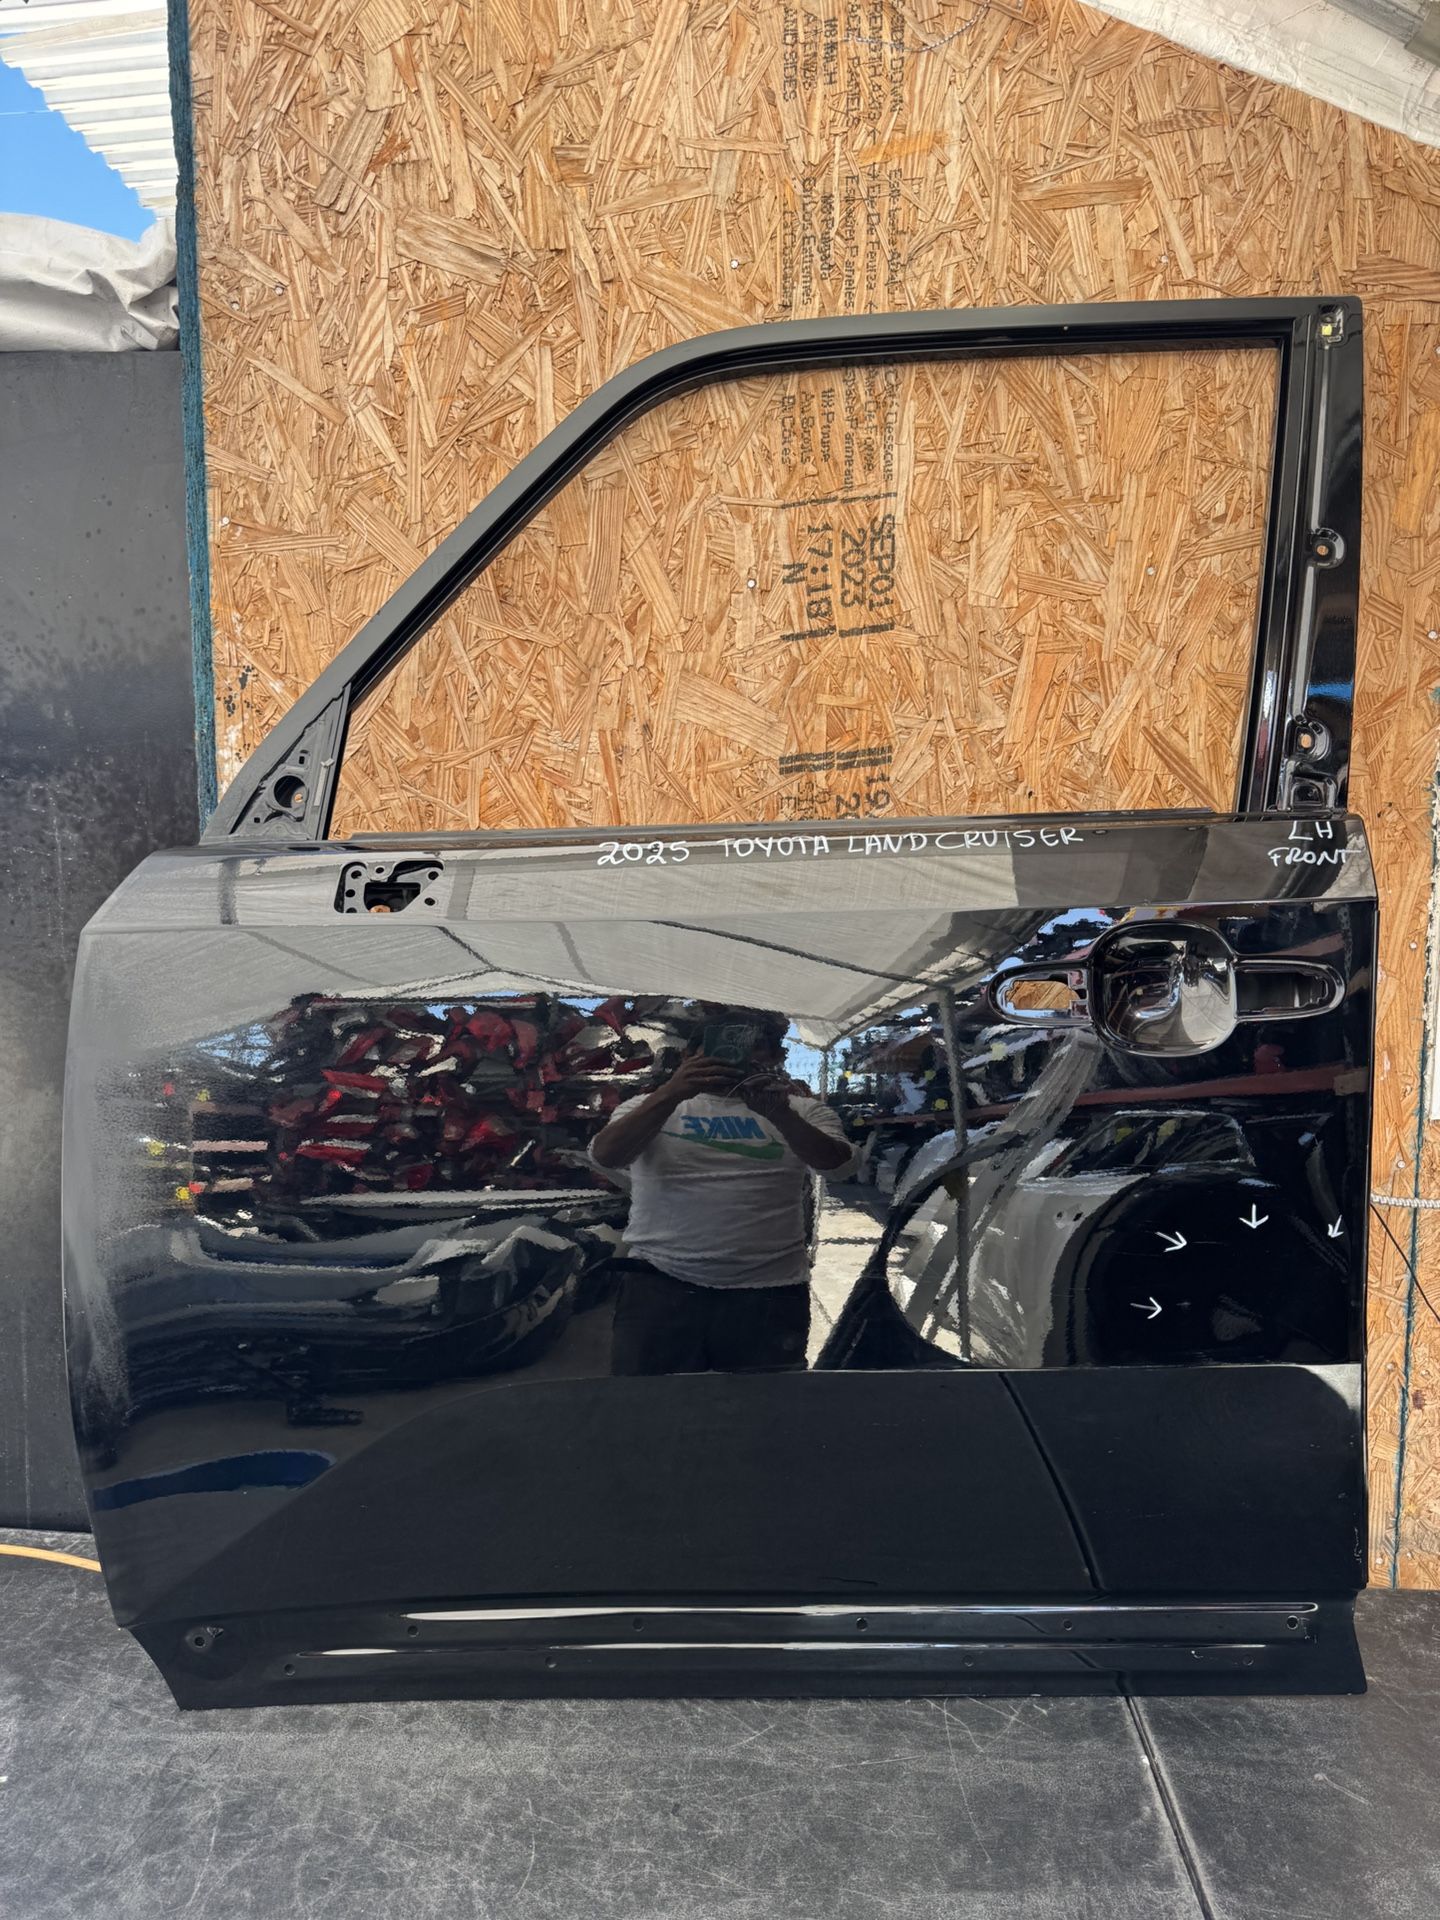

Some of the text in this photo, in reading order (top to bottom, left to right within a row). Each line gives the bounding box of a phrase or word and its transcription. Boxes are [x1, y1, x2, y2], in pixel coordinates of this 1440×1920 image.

[783, 8, 798, 102] AND SIDES
[844, 245, 859, 309] Paneles
[782, 562, 808, 585] N
[806, 521, 834, 620] 17:18
[840, 527, 867, 609] 2023
[597, 841, 690, 866] 2025
[716, 835, 830, 858] TOYOTA
[1267, 846, 1362, 867] FRONT
